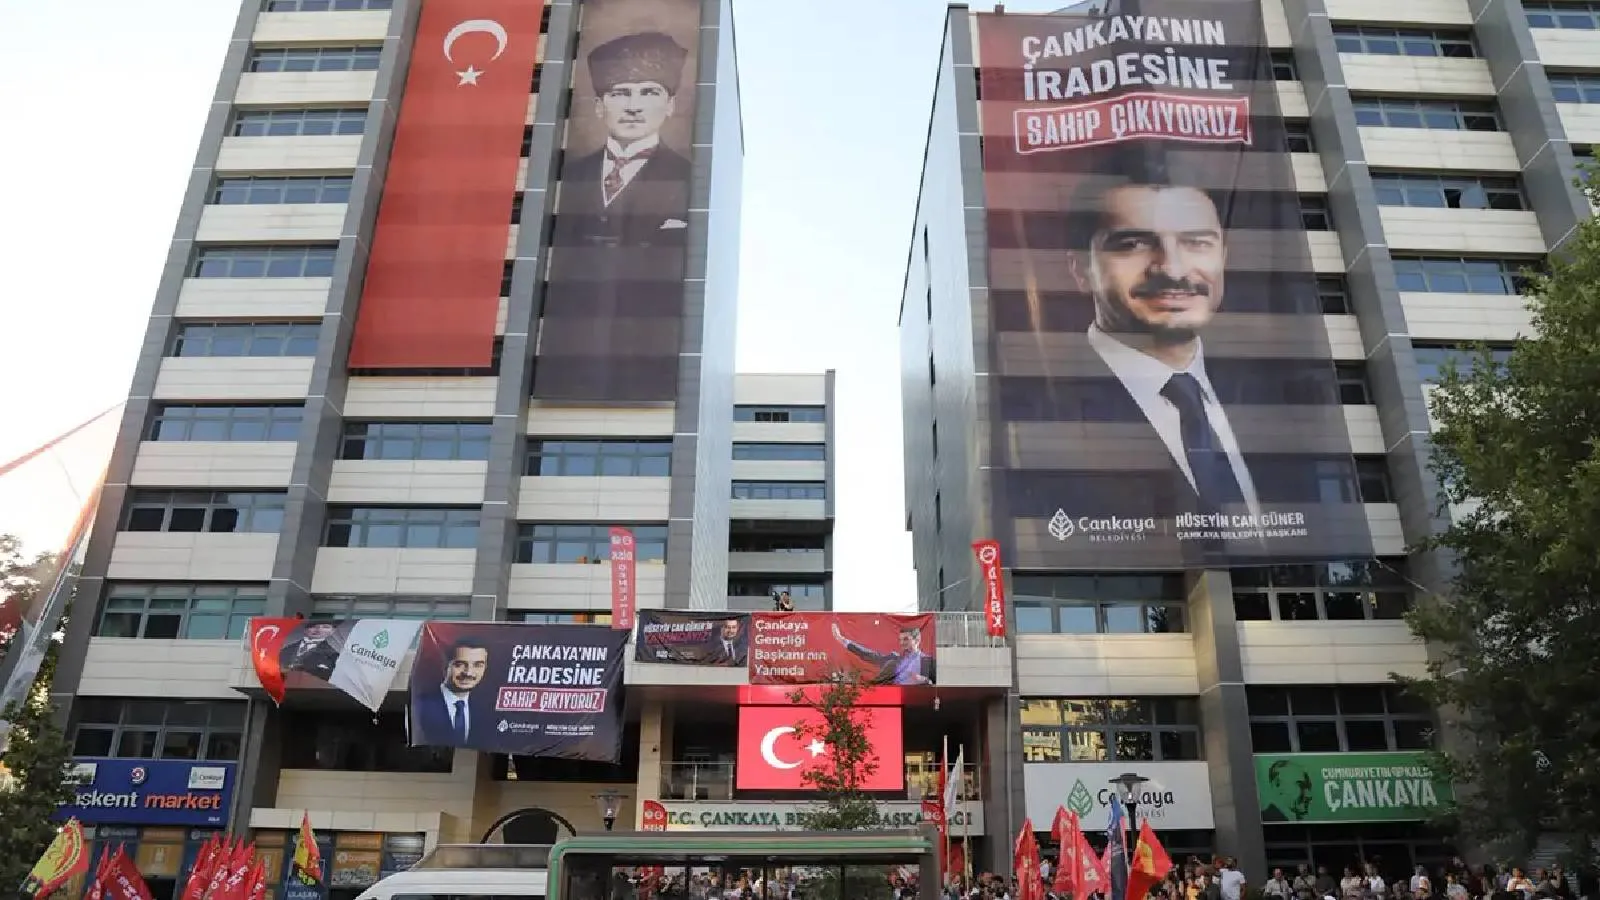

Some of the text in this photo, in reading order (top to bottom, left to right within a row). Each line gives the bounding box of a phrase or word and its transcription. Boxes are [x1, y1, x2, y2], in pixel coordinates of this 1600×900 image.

[1022, 15, 1225, 63] ÇANKAYA'NIN
[1024, 47, 1233, 101] İRADESİNE
[1027, 100, 1242, 145] SAHİP ÇIKIYORUZ
[1078, 512, 1304, 532] Çankaya HÜSEYİN CAN GÜNER
[755, 619, 808, 632] Çankaya
[755, 634, 805, 647] Gençliği
[512, 645, 608, 661] ÇANKAYA'NIN
[507, 661, 604, 685] İRADESİNE
[755, 664, 804, 676] Yanında
[503, 691, 600, 710] SAHİP ÇIKIYORUZ
[144, 792, 221, 810] market
[1324, 779, 1438, 813] ÇANKAYA
[701, 811, 780, 828] ÇANKAYA
